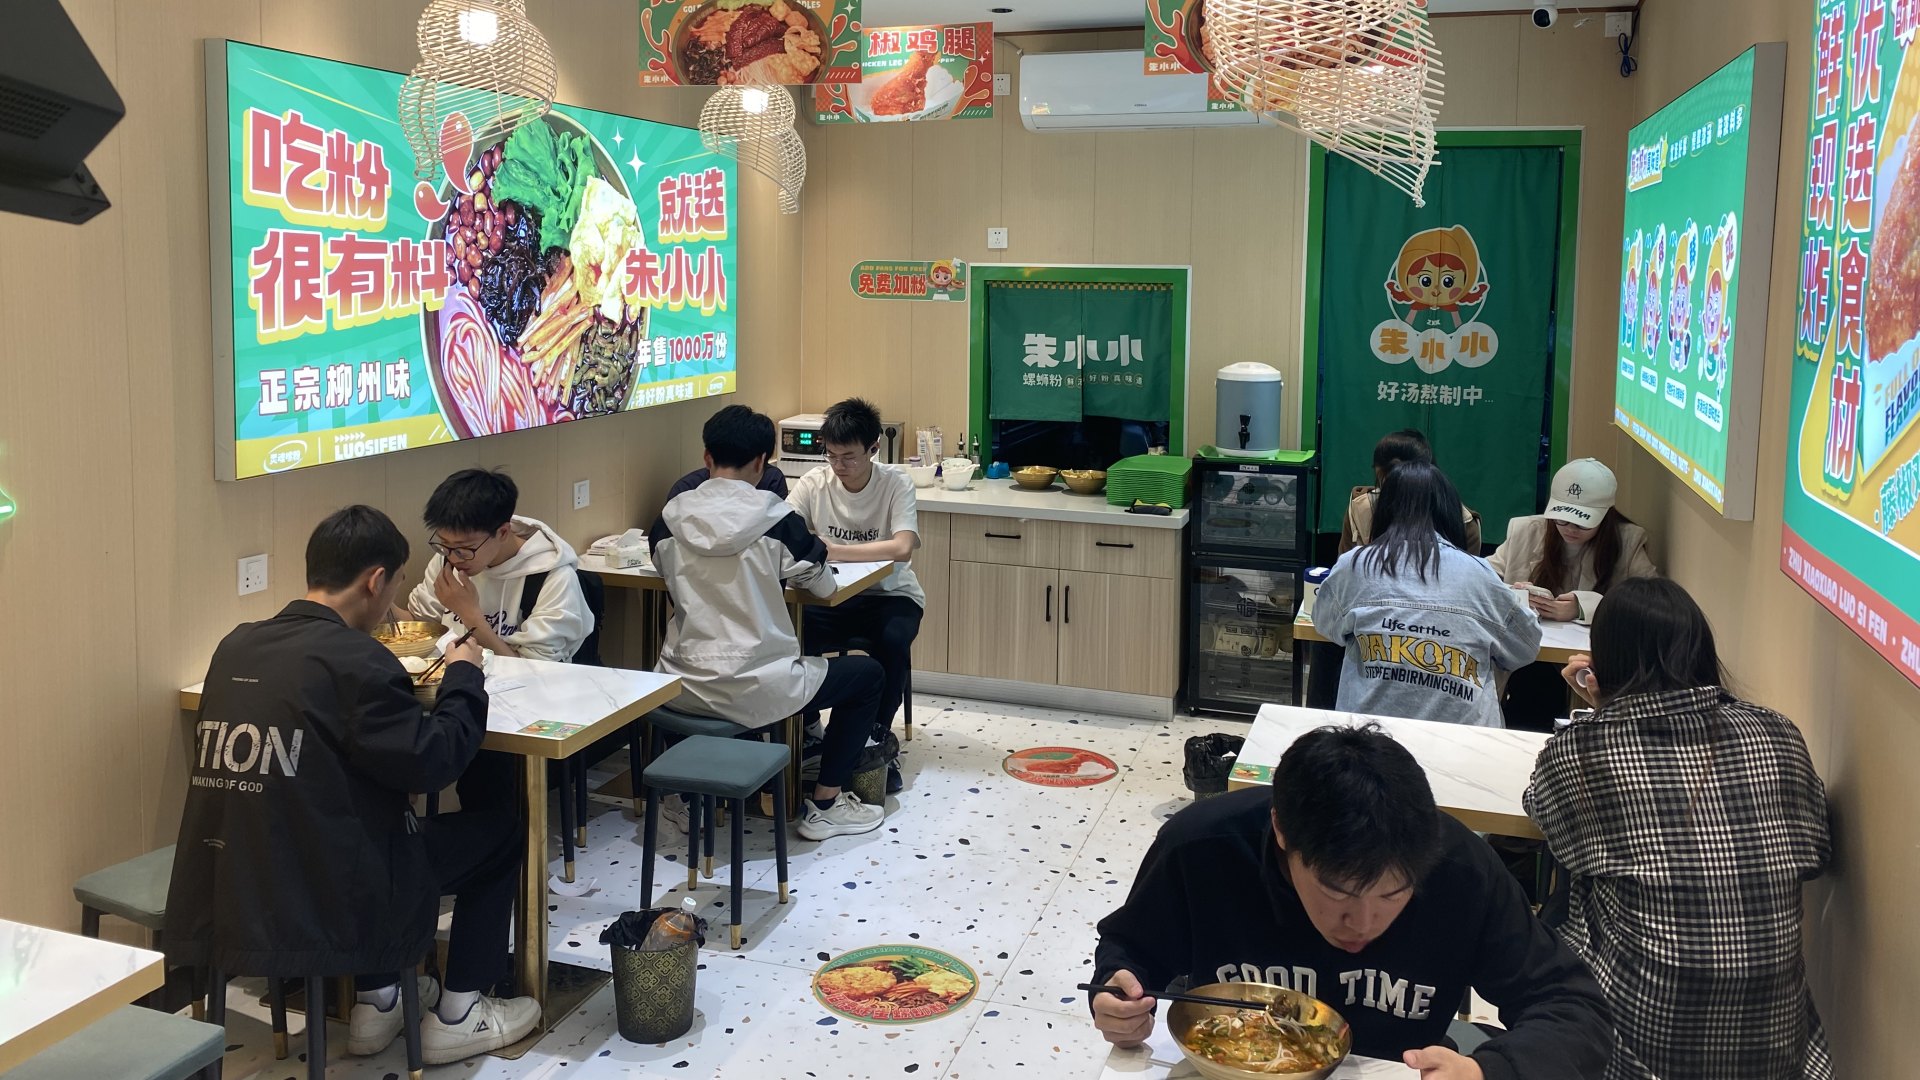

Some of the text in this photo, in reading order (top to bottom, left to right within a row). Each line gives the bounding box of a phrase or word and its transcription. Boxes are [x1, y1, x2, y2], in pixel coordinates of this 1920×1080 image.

[868, 27, 976, 60] 椒鸡腿
[1148, 62, 1181, 72] 朱小小
[248, 106, 391, 224] 吃粉
[657, 167, 727, 238] 就选
[251, 228, 452, 335] 很有料
[624, 246, 728, 311] 朱小小
[858, 273, 926, 296] 免费加粉
[637, 332, 728, 369] 年售1000万份
[1022, 333, 1143, 369] 朱小小
[1379, 328, 1490, 365] 朱小小
[259, 357, 411, 416] 正宗柳州味
[630, 382, 694, 409] 汤好粉真味道
[1023, 373, 1062, 387] 螺蛳粉
[1885, 366, 1920, 429] FLAVO
[1885, 386, 1920, 448] FLAVO
[334, 433, 408, 461] LUOSIFEN
[1788, 546, 1802, 576] ZHU
[1803, 560, 1838, 604] XIAOXIAO
[1839, 587, 1856, 619] LUO
[1857, 601, 1867, 628] SI
[1868, 609, 1888, 646] FEN
[1382, 617, 1406, 631] Life
[196, 720, 304, 777] TION
[238, 781, 263, 793] GOD
[1339, 968, 1436, 1021] TIME
